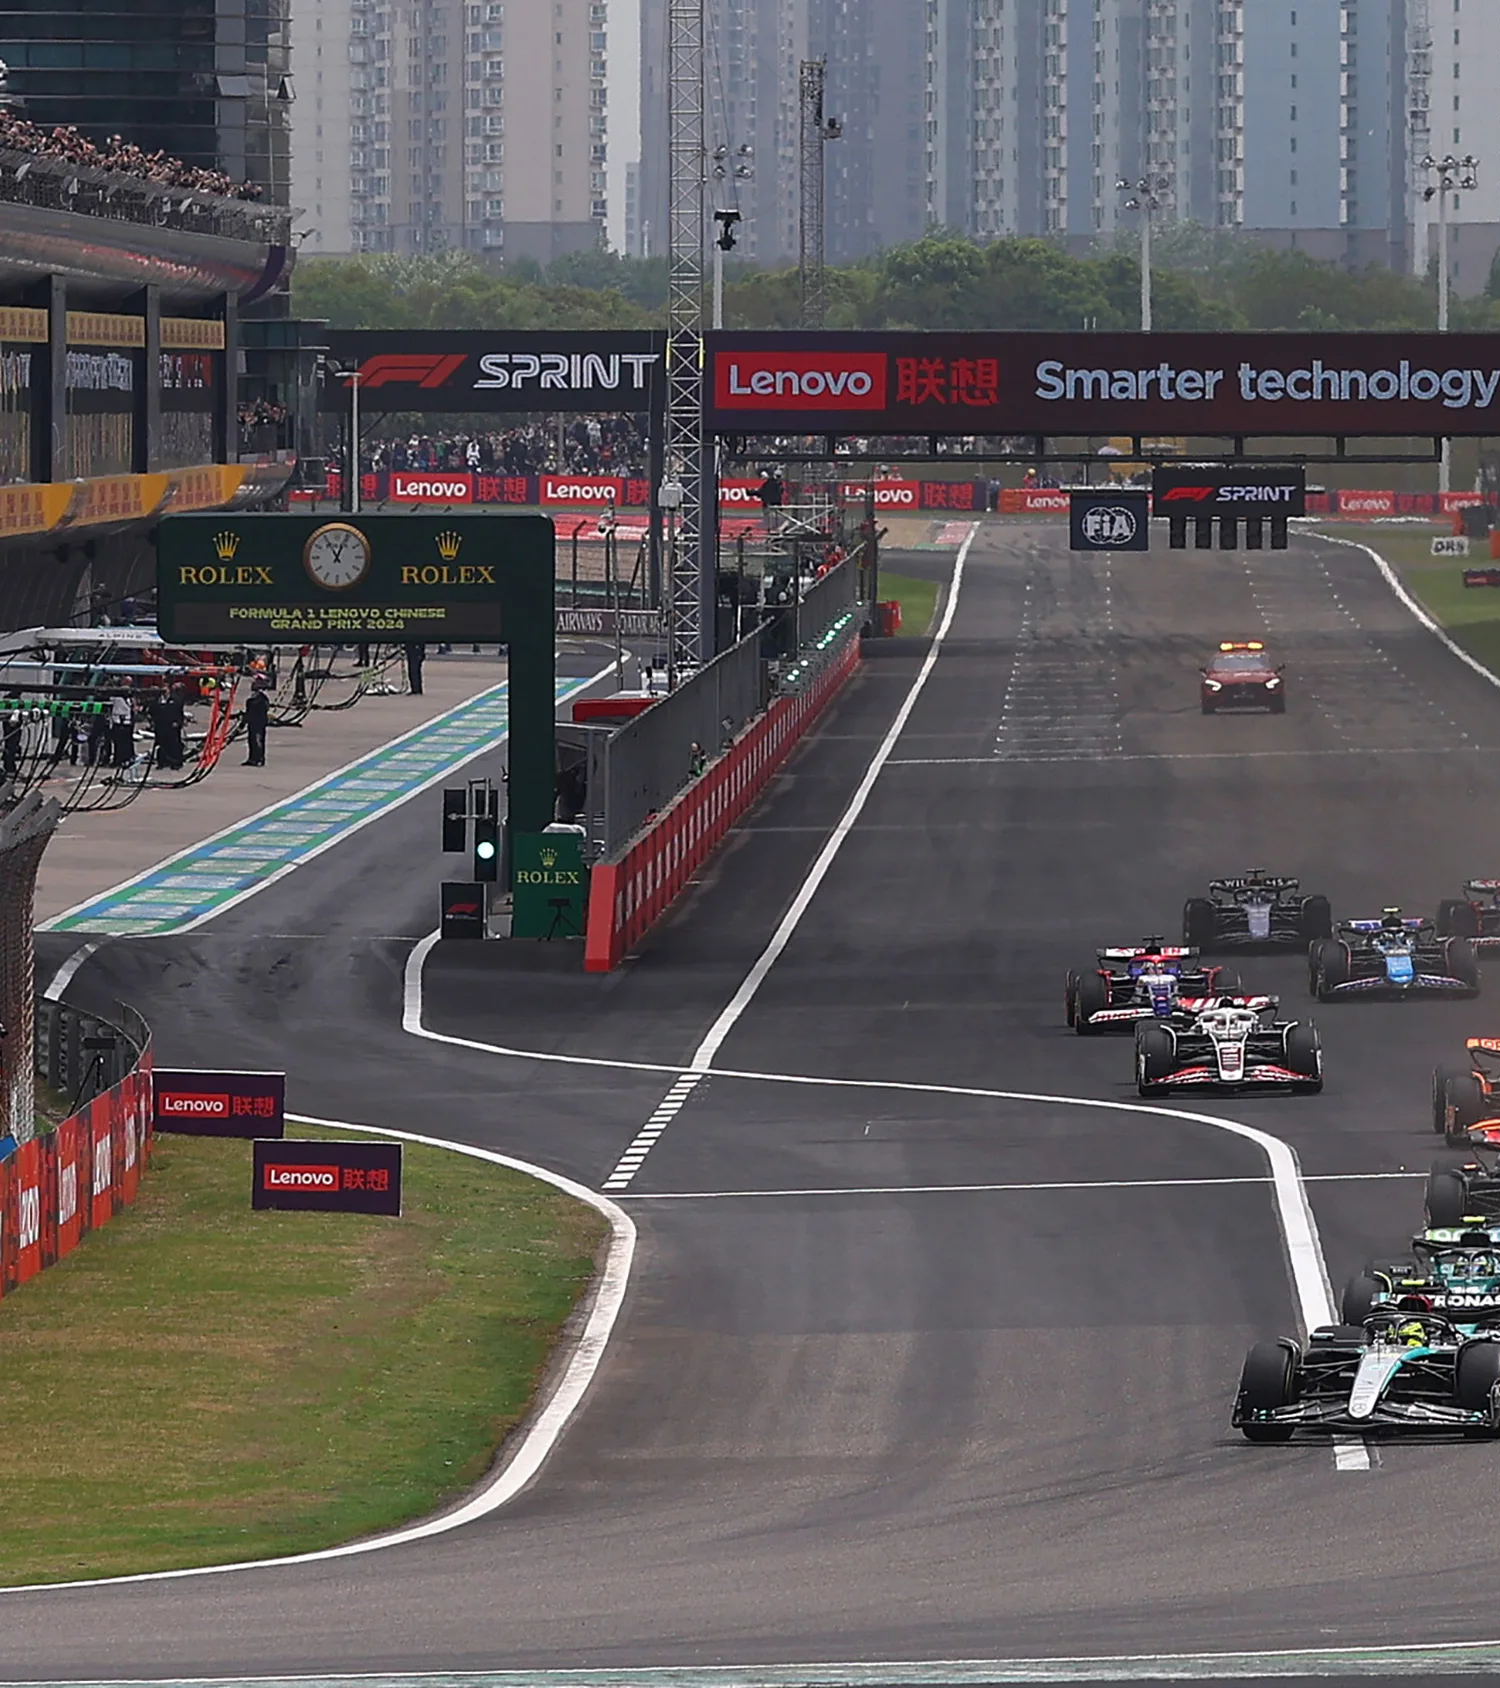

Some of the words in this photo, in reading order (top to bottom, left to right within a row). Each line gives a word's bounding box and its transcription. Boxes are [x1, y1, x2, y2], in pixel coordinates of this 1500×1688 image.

[473, 354, 659, 388] SPRINT
[730, 365, 871, 396] Lenovo
[895, 357, 1000, 406] 联想
[1036, 360, 1222, 400] Smarter
[1239, 360, 1500, 408] technology
[396, 479, 467, 497] Lenovo
[477, 477, 527, 501] 联想
[547, 482, 615, 500] Lenovo
[1216, 486, 1296, 501] SPRINT
[181, 566, 273, 585] ROLEX
[401, 566, 495, 585] ROLEX
[230, 608, 302, 619] FORMULA
[307, 608, 316, 619] 1
[320, 608, 380, 619] LENOVO
[384, 608, 446, 619] CHINESE
[557, 613, 602, 632] AIRWAYS
[270, 619, 323, 630] GRAND
[327, 619, 361, 630] PRIX
[366, 619, 405, 630] 2024
[517, 870, 579, 884] ROLEX
[165, 1097, 224, 1112] Lenovo
[233, 1096, 274, 1117] 联想
[270, 1169, 334, 1186] Lenovo
[343, 1168, 389, 1191] 联想
